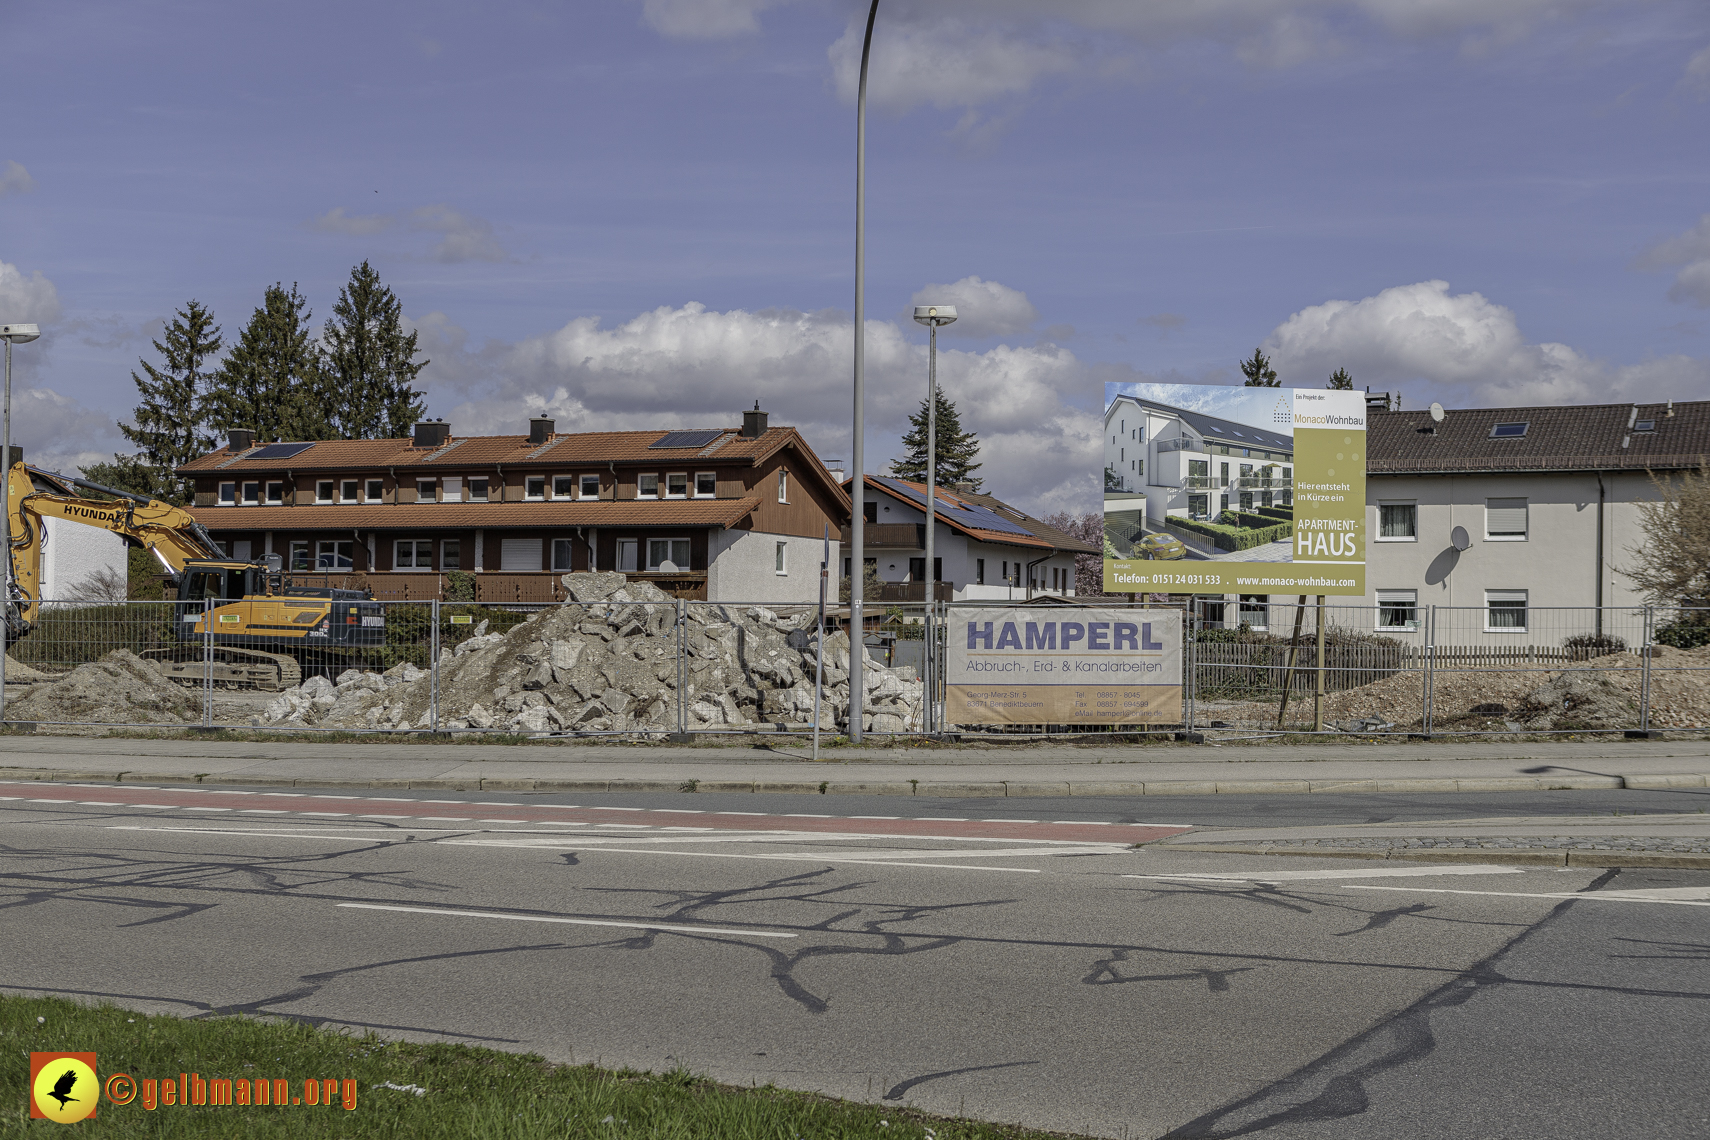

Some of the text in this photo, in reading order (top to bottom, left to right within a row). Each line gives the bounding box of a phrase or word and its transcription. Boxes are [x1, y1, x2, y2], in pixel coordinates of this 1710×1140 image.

[1294, 414, 1364, 425] MonacoWohnbau
[1307, 493, 1330, 502] Kürze
[1298, 519, 1358, 530] APARTMENT-
[1298, 532, 1356, 556] HAUS
[1114, 574, 1149, 584] Telefon:
[1152, 574, 1173, 584] 0151
[1176, 574, 1186, 584] 24
[1188, 575, 1203, 584] 031
[1205, 575, 1220, 584] 533
[1236, 577, 1356, 586] www.monaco-wohnbau.com
[967, 622, 1162, 650] HAMPERL
[966, 660, 1162, 672] Abbruch-, Erd- & Kanalarbeiten
